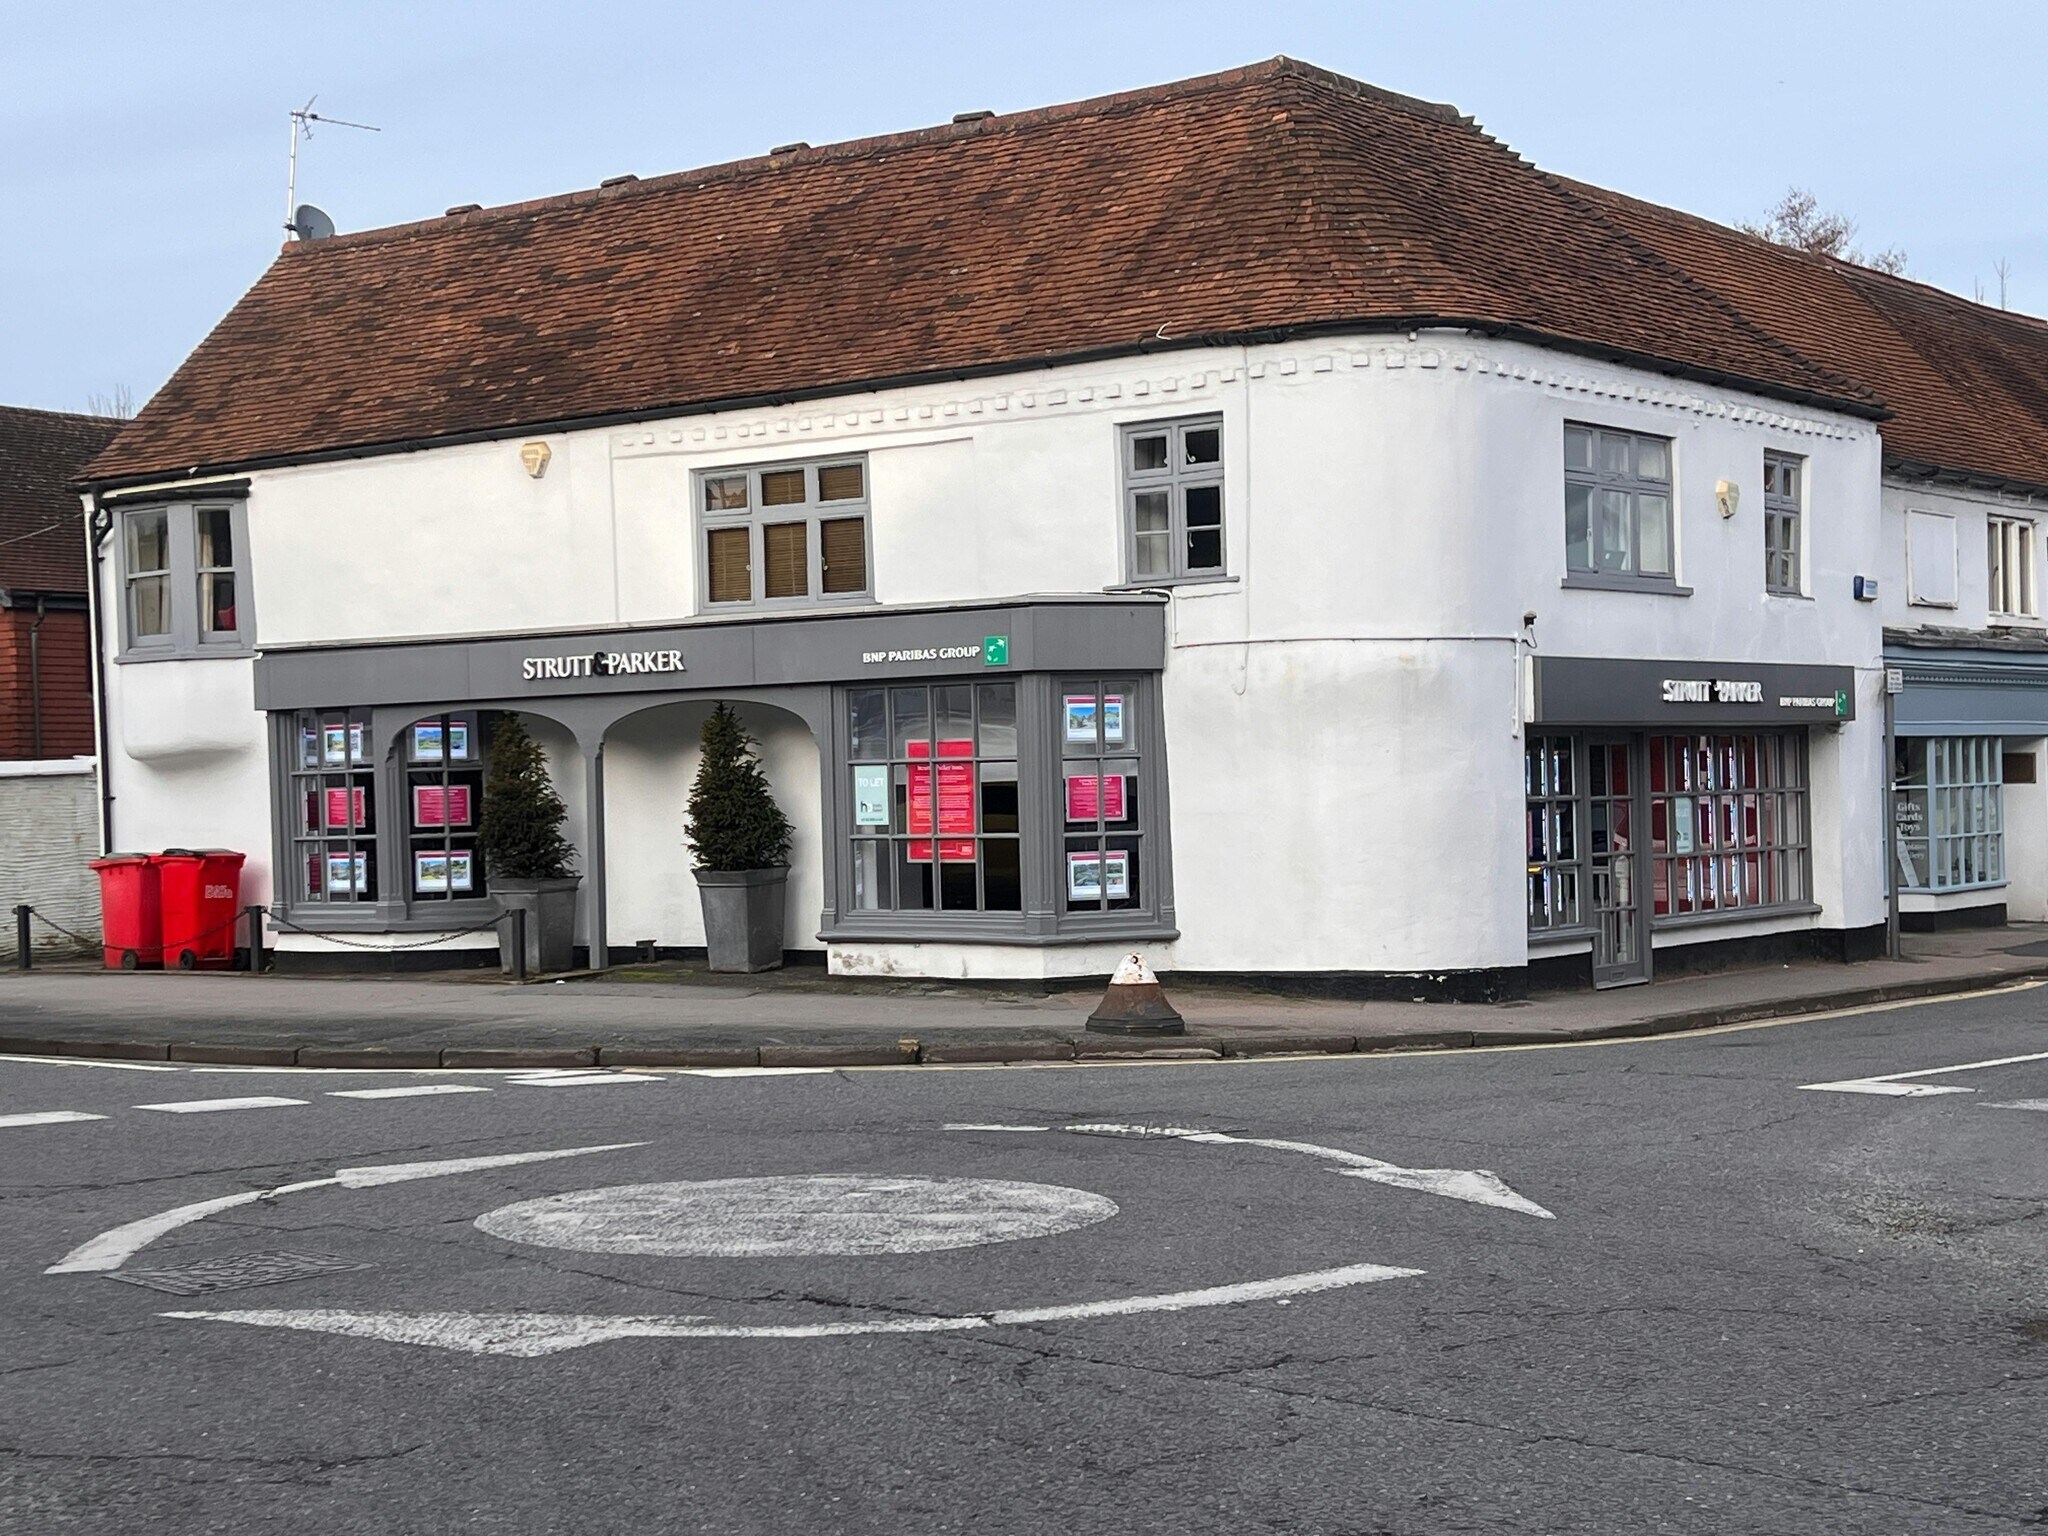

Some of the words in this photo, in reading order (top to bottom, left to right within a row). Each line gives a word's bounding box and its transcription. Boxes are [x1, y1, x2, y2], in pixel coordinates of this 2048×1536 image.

[863, 651, 886, 663] BNP
[888, 648, 937, 662] PARIBAS
[939, 646, 980, 658] GROUP
[858, 777, 869, 788] TO
[870, 777, 884, 787] LET
[1897, 802, 1921, 812] Gifts
[1896, 812, 1923, 821] Cards
[1899, 823, 1921, 833] Toys
